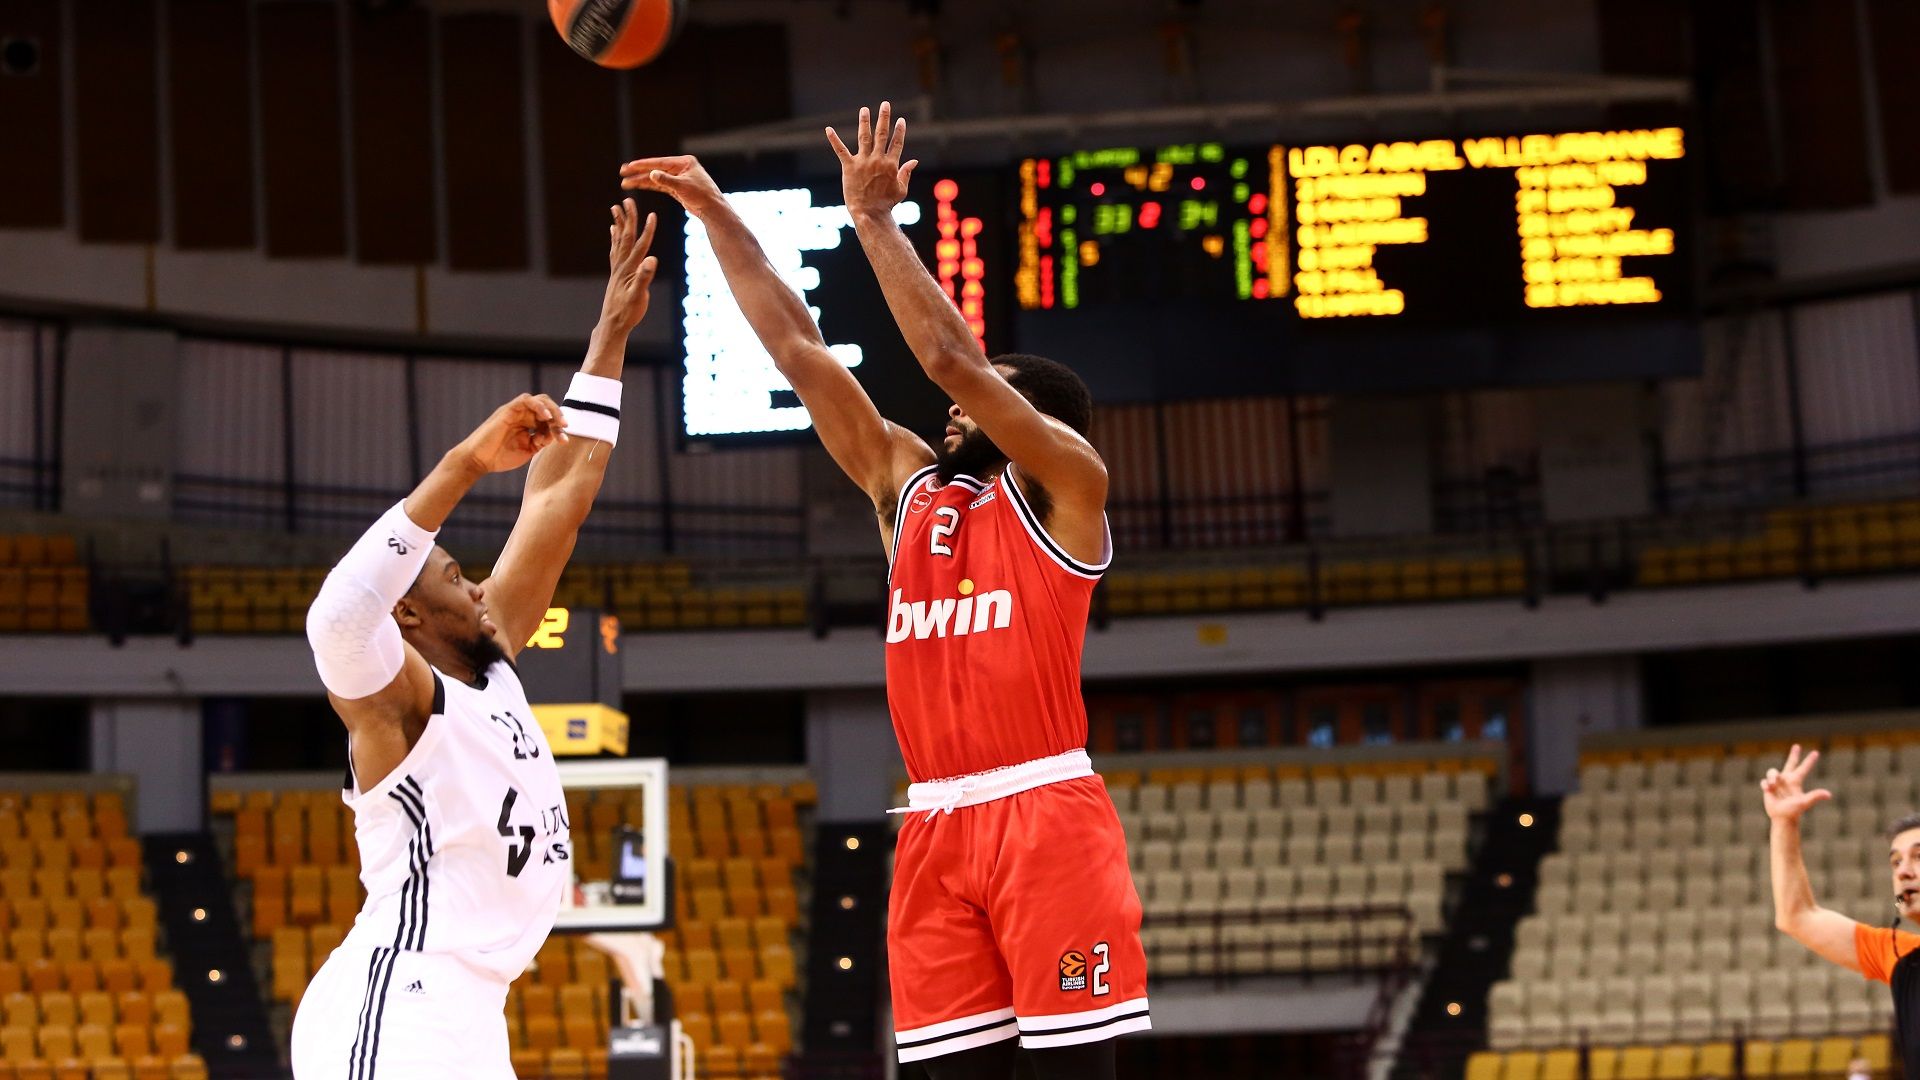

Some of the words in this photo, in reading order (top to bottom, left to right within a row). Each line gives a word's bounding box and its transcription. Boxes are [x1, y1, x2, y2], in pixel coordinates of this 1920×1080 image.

[930, 506, 961, 557] 2
[886, 579, 1012, 644] bwin
[1093, 943, 1110, 996] 2
